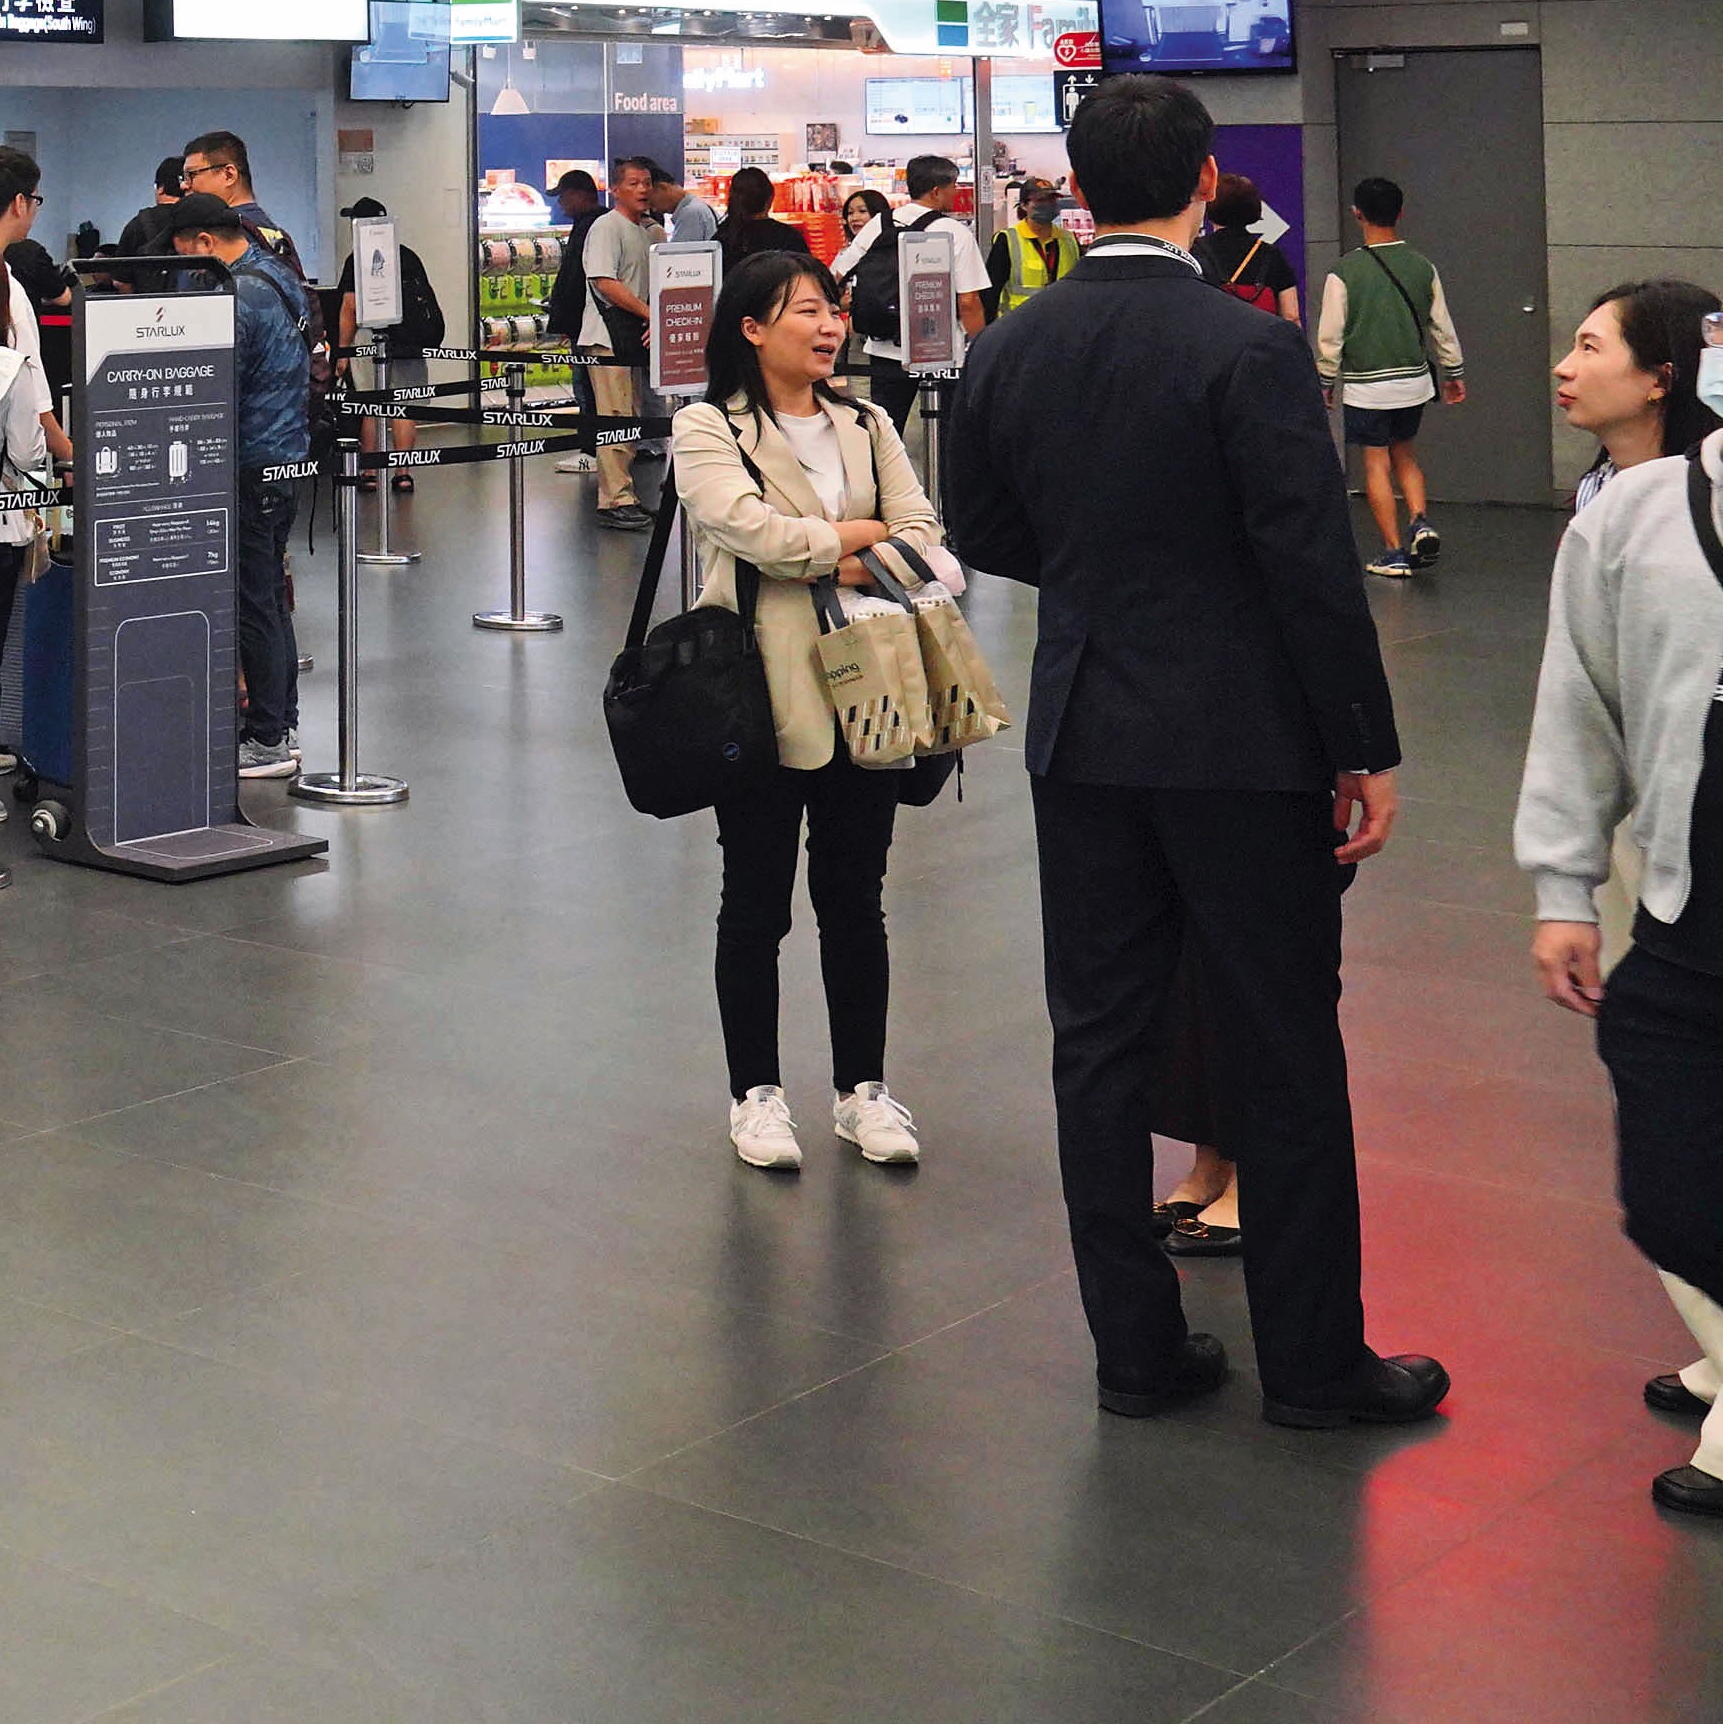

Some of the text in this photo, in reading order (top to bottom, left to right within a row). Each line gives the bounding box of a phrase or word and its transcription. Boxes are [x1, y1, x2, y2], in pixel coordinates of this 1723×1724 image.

[974, 1, 1019, 47] 全家
[614, 93, 677, 112] Food area
[666, 303, 702, 313] PREMIUM
[136, 325, 186, 338] STARLUX
[422, 348, 600, 366] STARLUX STARLUX
[107, 365, 215, 384] CARRY-ON BAGGAGE
[394, 386, 436, 401] STARLUX
[342, 402, 553, 427] STARLUX STARLUX
[388, 427, 641, 467] STARLUX STARLUX STARLUX
[263, 460, 318, 482] STARLUX
